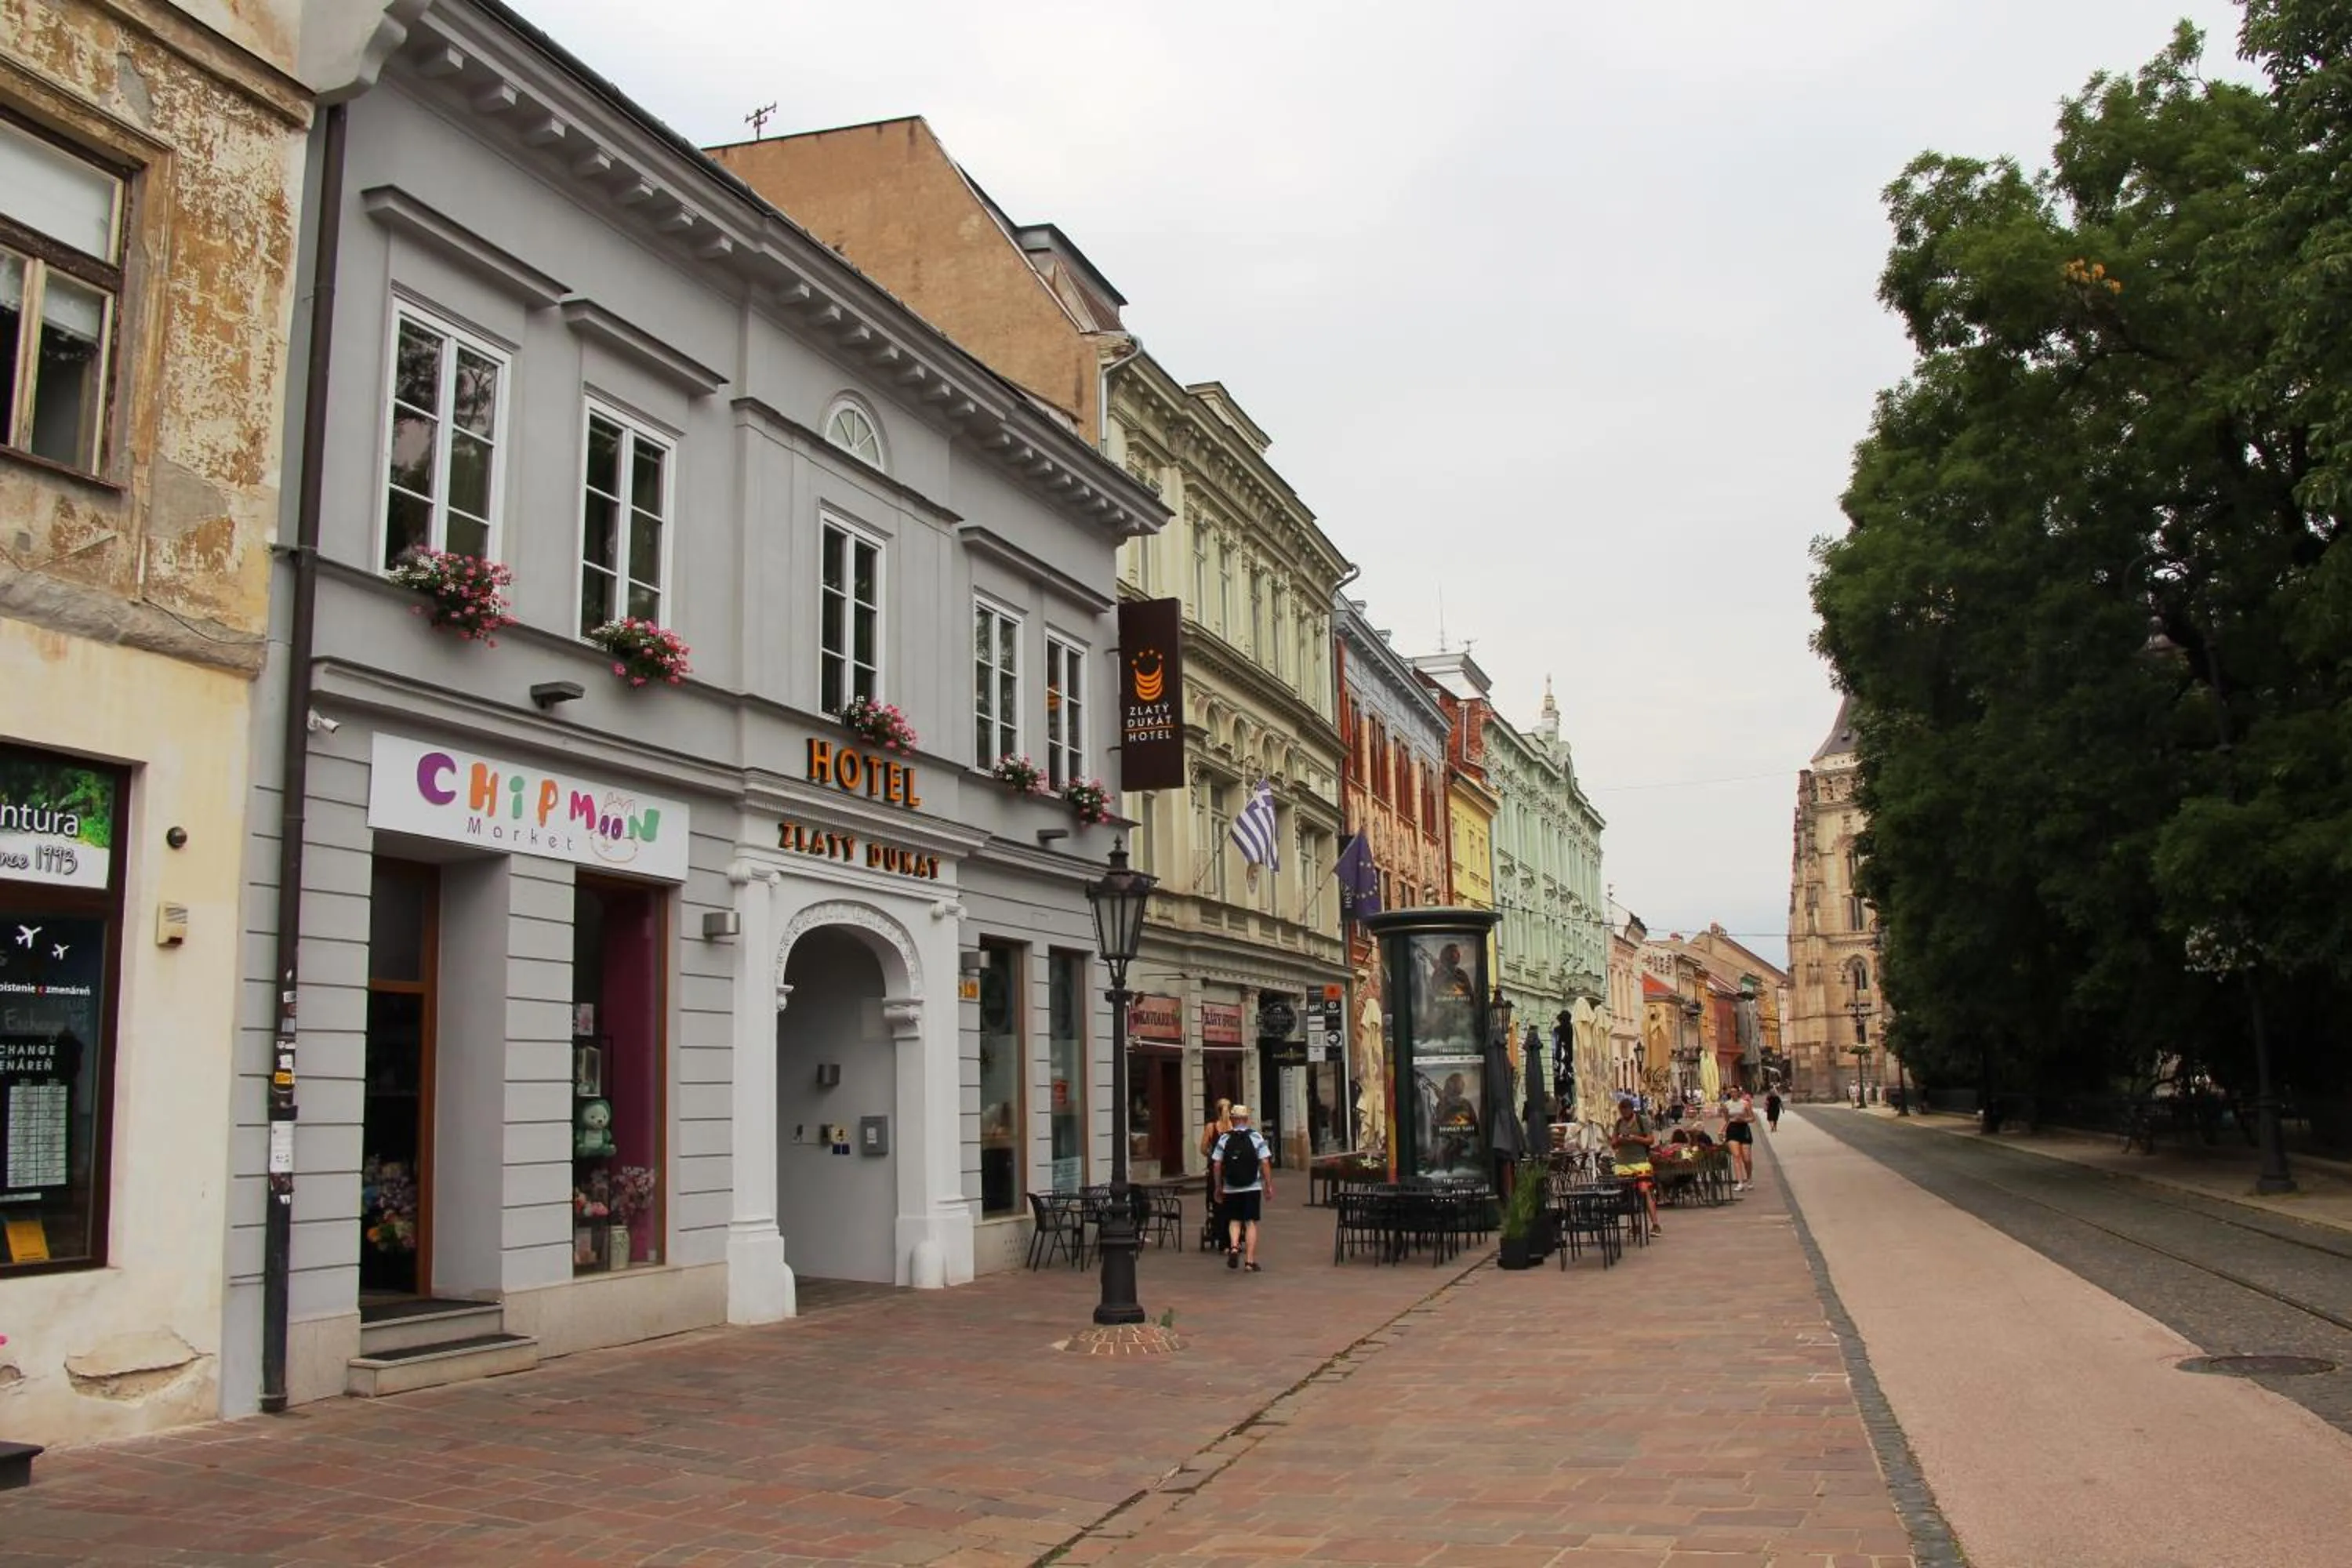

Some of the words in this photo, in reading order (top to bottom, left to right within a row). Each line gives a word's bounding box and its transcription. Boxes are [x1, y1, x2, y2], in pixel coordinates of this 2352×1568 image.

[1128, 729, 1172, 742] HOTEL
[806, 737, 923, 808] HOTEL
[35, 842, 78, 876] 1993
